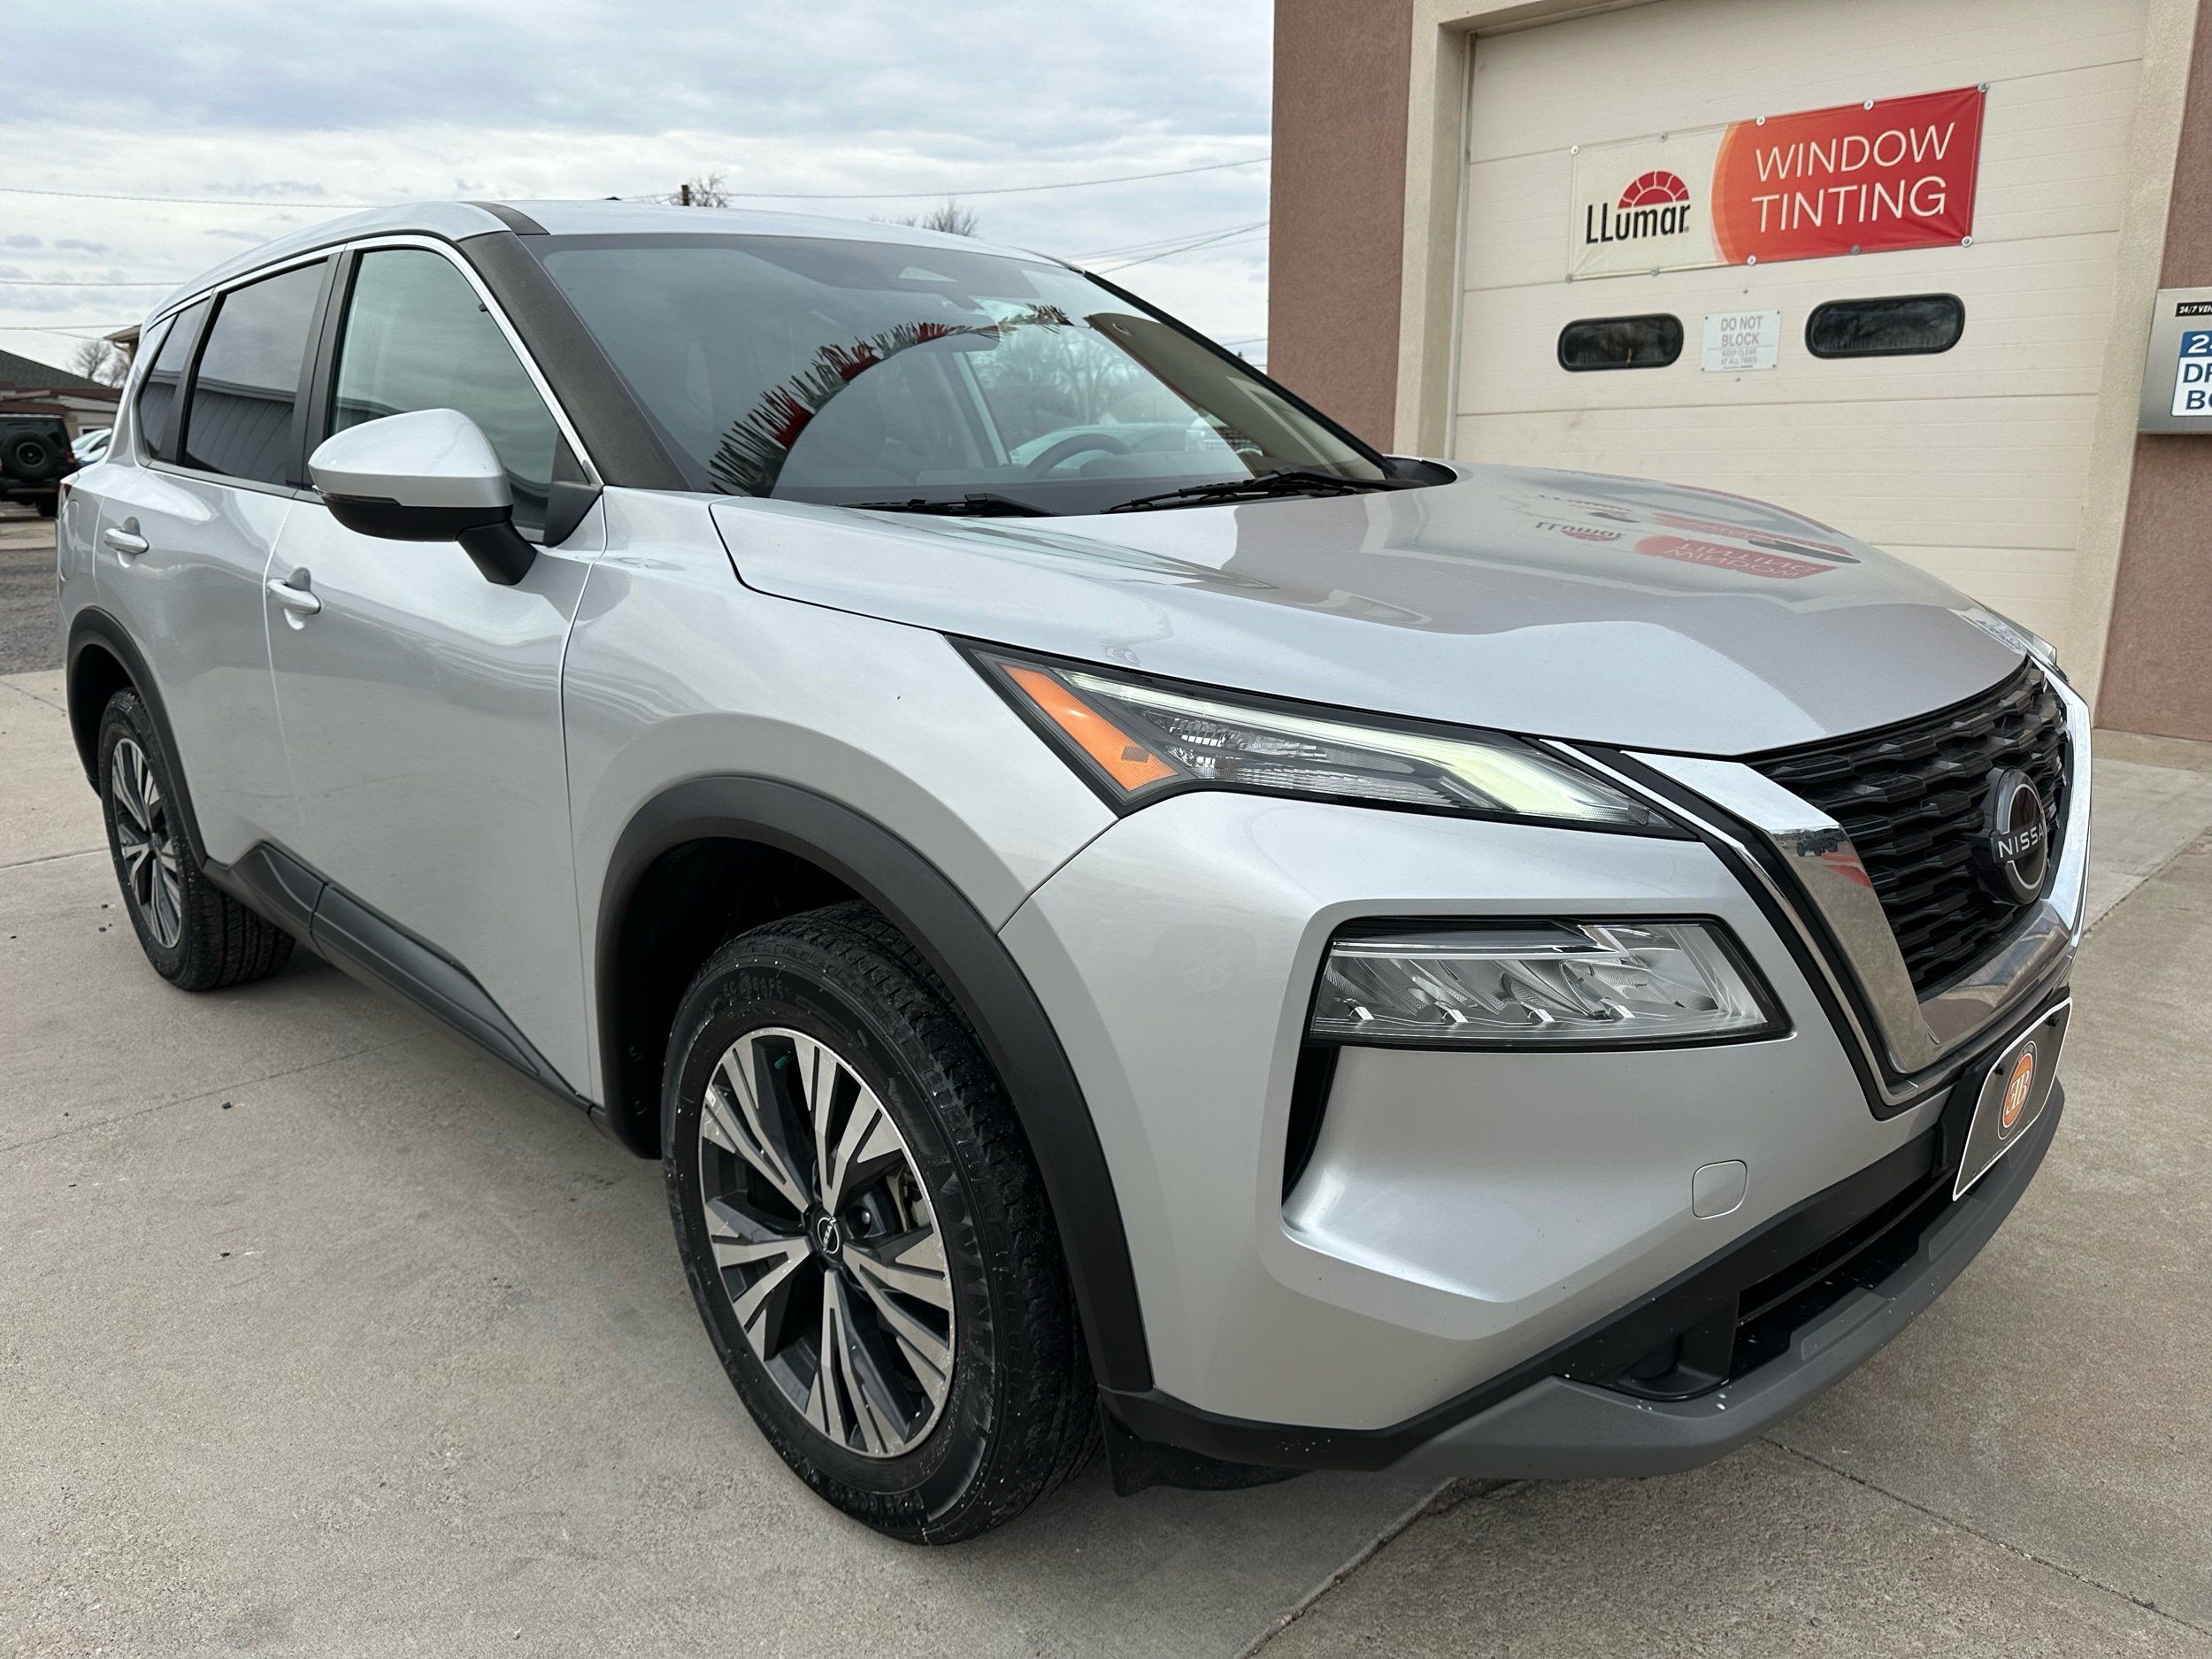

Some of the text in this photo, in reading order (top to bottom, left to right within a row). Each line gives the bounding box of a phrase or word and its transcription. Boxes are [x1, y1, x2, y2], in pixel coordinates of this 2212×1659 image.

[1755, 122, 1955, 182] WINDOW
[1751, 175, 1947, 233] TINTING
[1586, 204, 1691, 244] LLumar
[2179, 304, 2212, 314] 24/7 VEH
[1721, 315, 1763, 332] DO NOT
[1721, 333, 1760, 347] BLOCK
[2187, 334, 2212, 354] 2
[1997, 822, 2045, 858] NISSA
